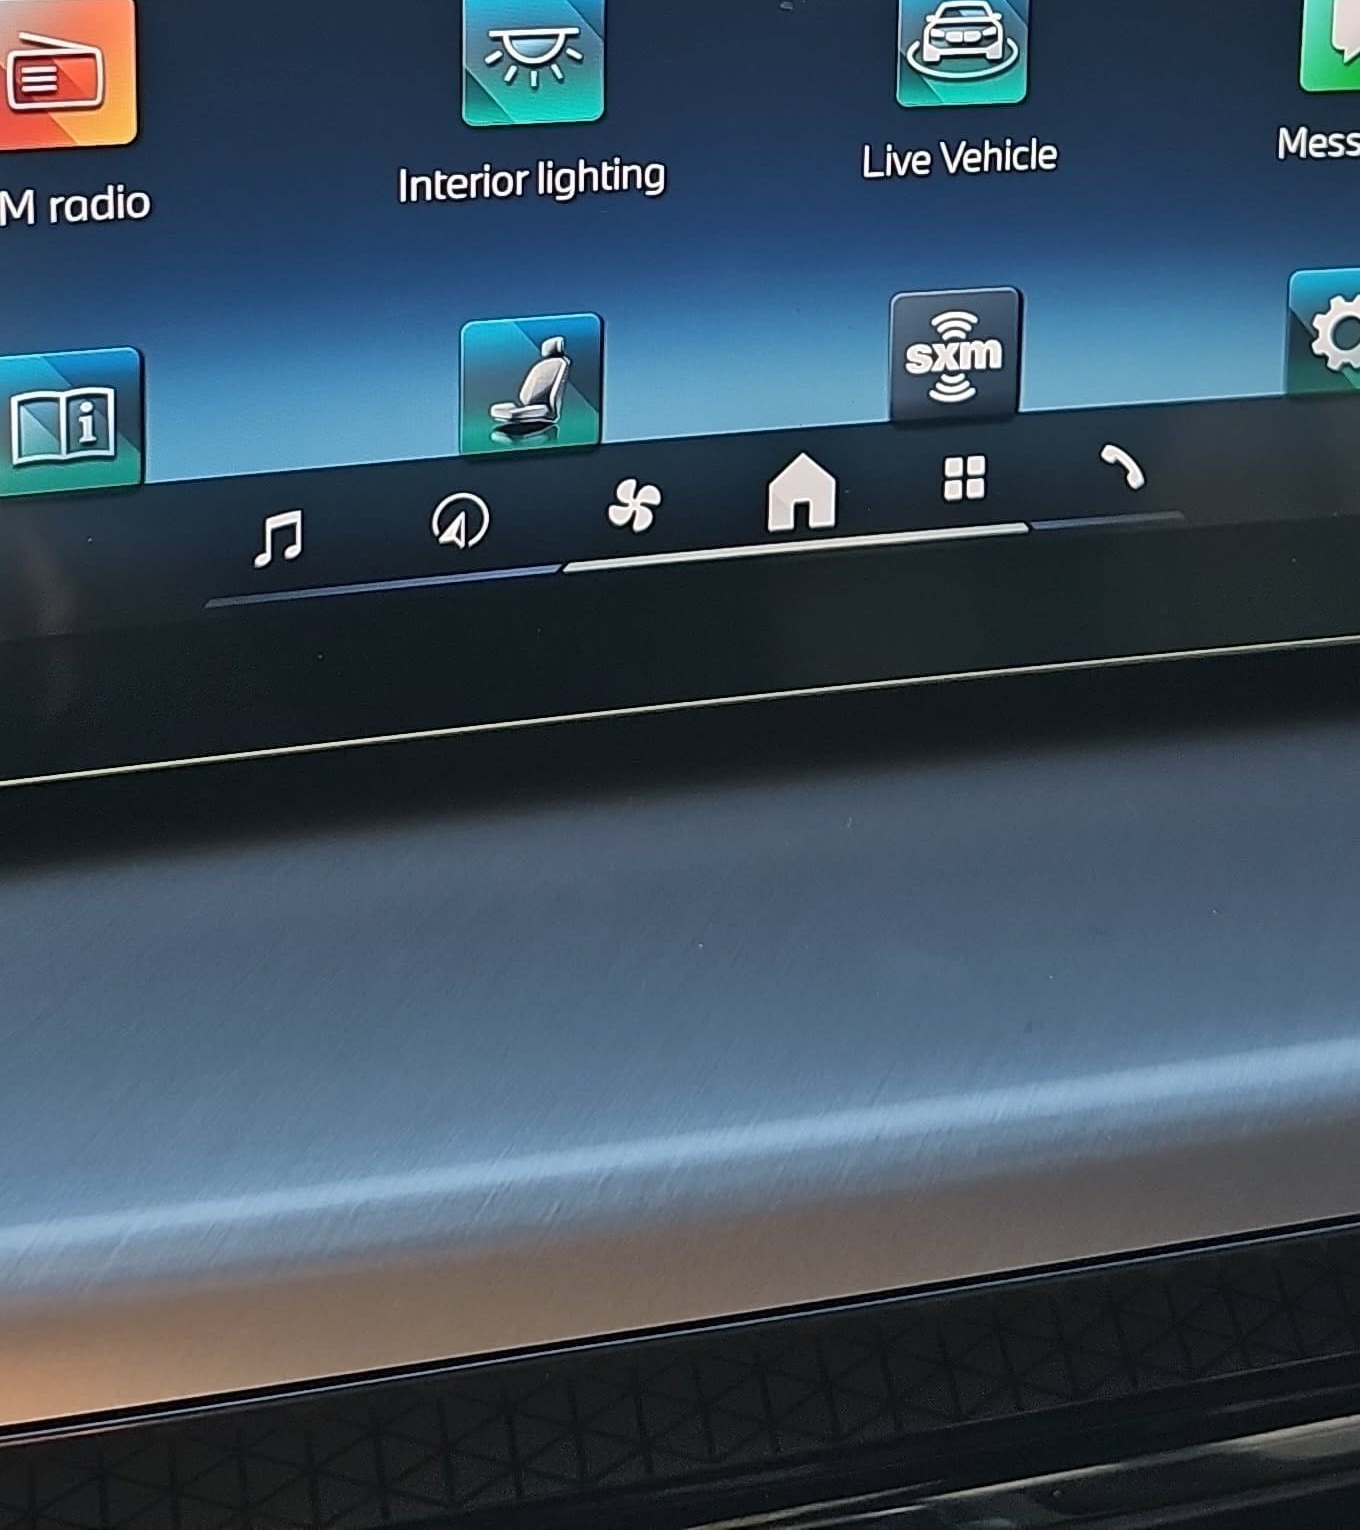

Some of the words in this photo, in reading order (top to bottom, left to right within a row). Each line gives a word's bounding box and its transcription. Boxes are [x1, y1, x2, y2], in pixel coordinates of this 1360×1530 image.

[862, 142, 932, 179] Live
[938, 136, 1059, 175] Vehicle
[399, 162, 531, 204] Interior
[537, 156, 666, 202] lighting
[48, 183, 152, 224] radio
[904, 338, 1004, 375] sxm
